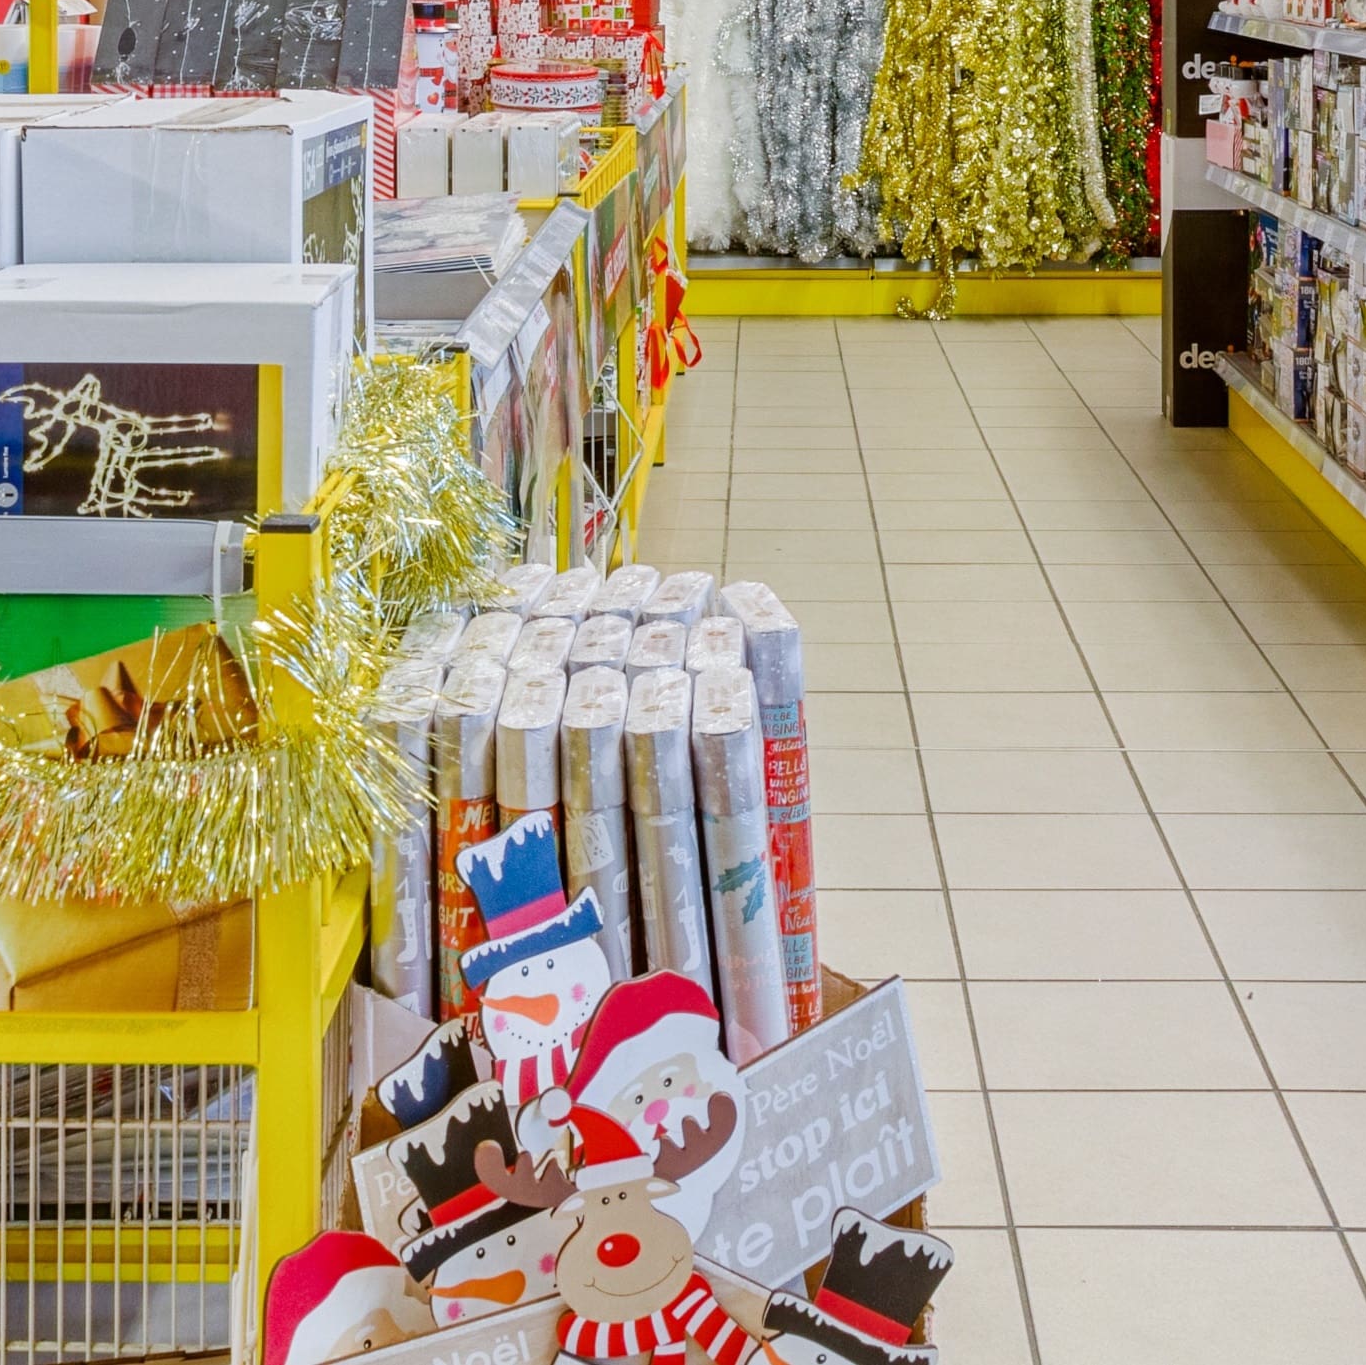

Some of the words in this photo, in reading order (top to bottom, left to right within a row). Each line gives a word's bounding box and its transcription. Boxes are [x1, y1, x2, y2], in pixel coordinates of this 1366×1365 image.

[768, 755, 807, 777] BELLS
[769, 777, 794, 788] WILL
[748, 1071, 818, 1128] Père
[823, 1009, 898, 1081] Noël
[739, 1116, 831, 1194] stop
[839, 1070, 892, 1133] ici
[713, 1222, 775, 1269] te
[791, 1116, 915, 1250] plaît
